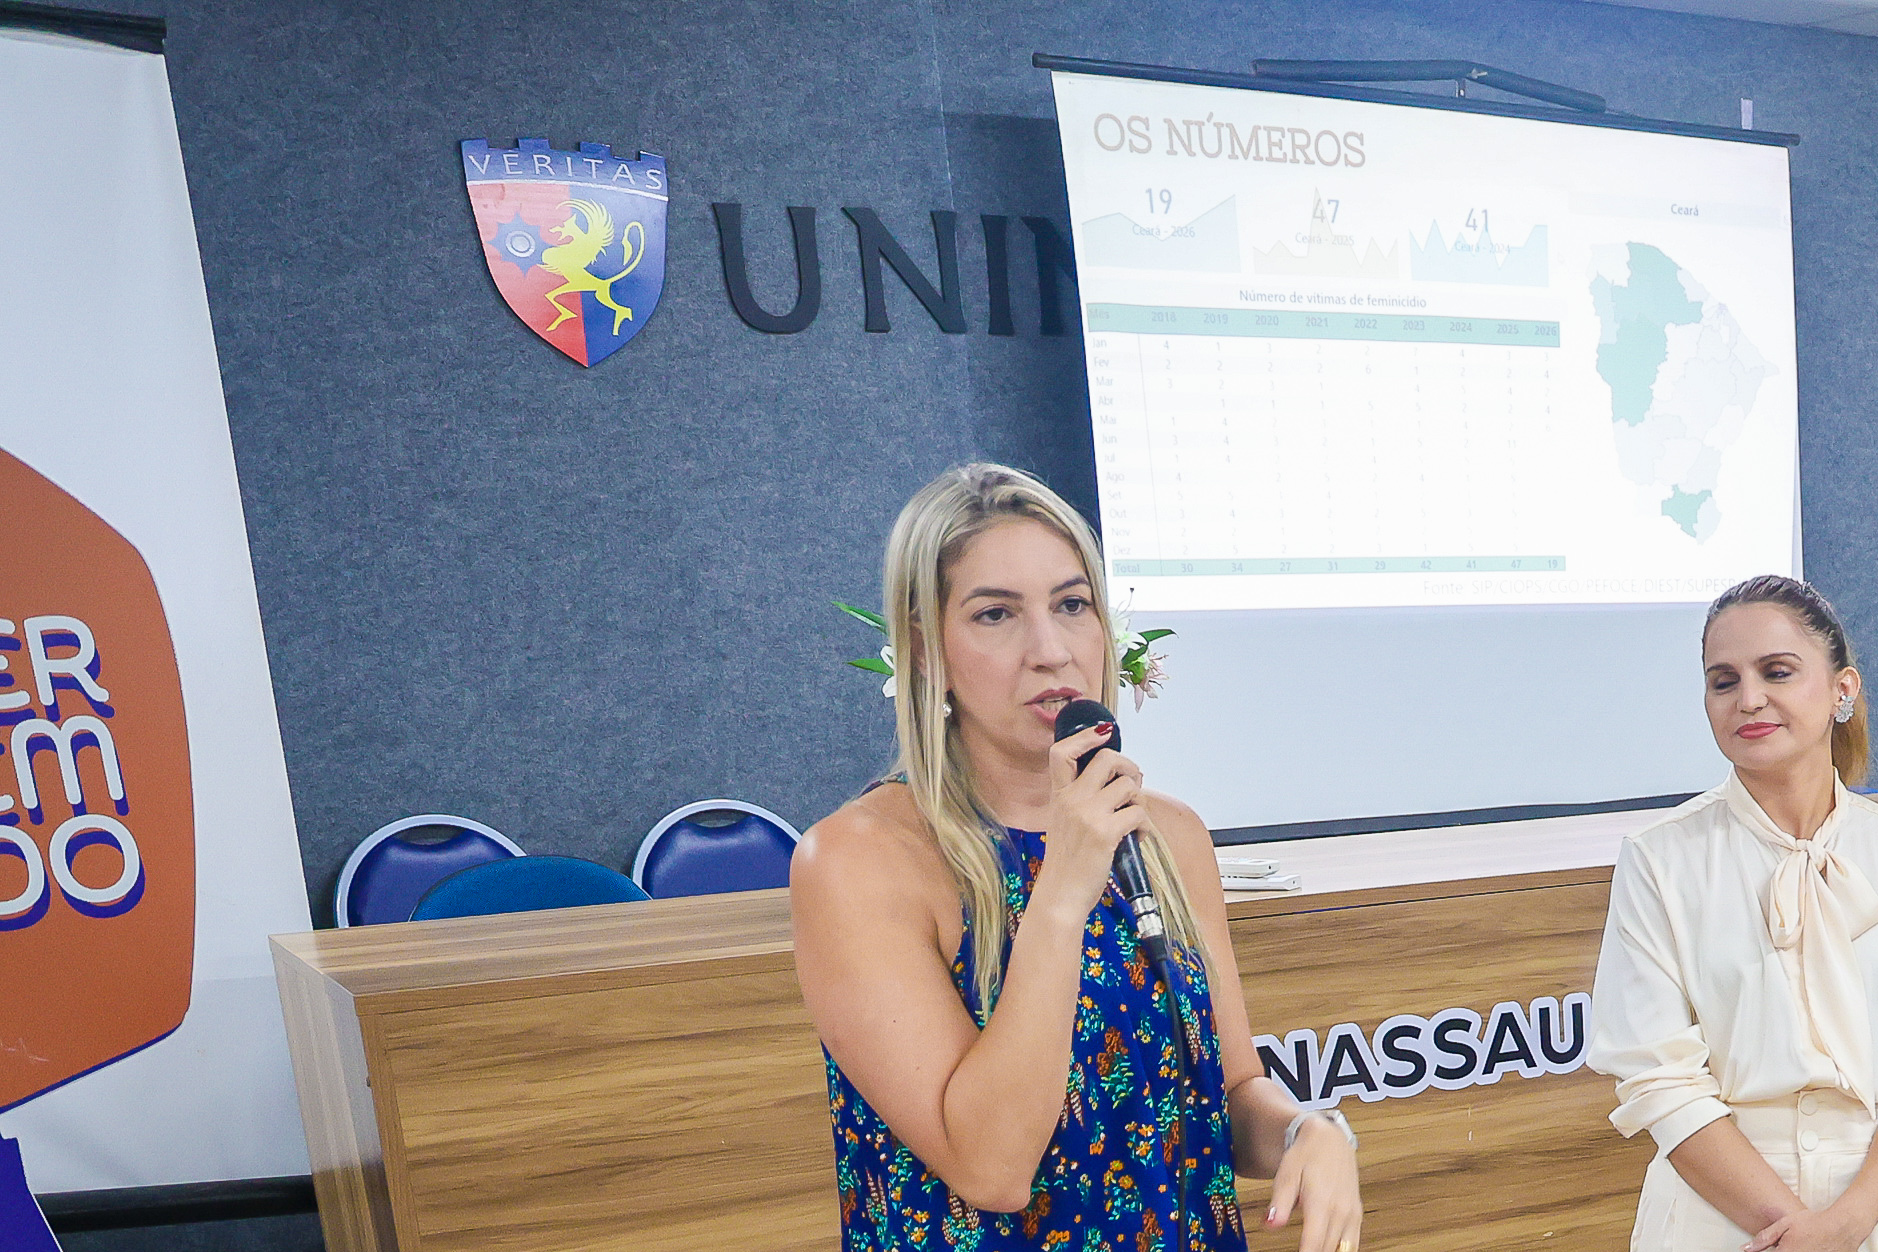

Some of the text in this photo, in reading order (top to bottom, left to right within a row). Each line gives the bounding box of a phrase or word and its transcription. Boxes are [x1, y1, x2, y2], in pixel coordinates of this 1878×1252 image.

[1094, 111, 1366, 168] OS NÚMEROS
[468, 152, 664, 191] VERITAS
[1145, 188, 1173, 214] 19
[1312, 197, 1340, 224] 47
[1670, 203, 1699, 217] Ceará
[1465, 207, 1489, 233] 41
[1132, 223, 1161, 237] Ceará
[1170, 225, 1196, 238] 2026
[1295, 232, 1322, 246] Ceará
[1331, 234, 1355, 247] 2025
[1454, 240, 1480, 254] Ceará
[1488, 242, 1511, 255] 2024
[1239, 289, 1427, 308] Número de vítimas de feminicídio
[1151, 311, 1177, 323] 2018
[1203, 312, 1229, 324] 2019
[1255, 314, 1280, 326] 2020
[1305, 316, 1329, 328] 2021
[1353, 318, 1378, 329] 2022
[1402, 319, 1425, 331] 2023
[1449, 321, 1473, 333] 2024
[1496, 323, 1520, 335] 2025
[1534, 325, 1557, 336] 2026
[1092, 337, 1107, 348] Jan
[1093, 356, 1110, 367] Fev
[1096, 376, 1113, 386] Mar
[1098, 395, 1113, 406] Abr
[1102, 433, 1117, 444] Jun
[1105, 471, 1125, 484] Ago
[1109, 507, 1127, 519] Out
[1111, 527, 1130, 537] Nov
[1113, 544, 1131, 555] Dez
[1115, 559, 1558, 574] Total 30 34 27 31 29 42 41 47 19
[1256, 1002, 1583, 1102] NASSAU
